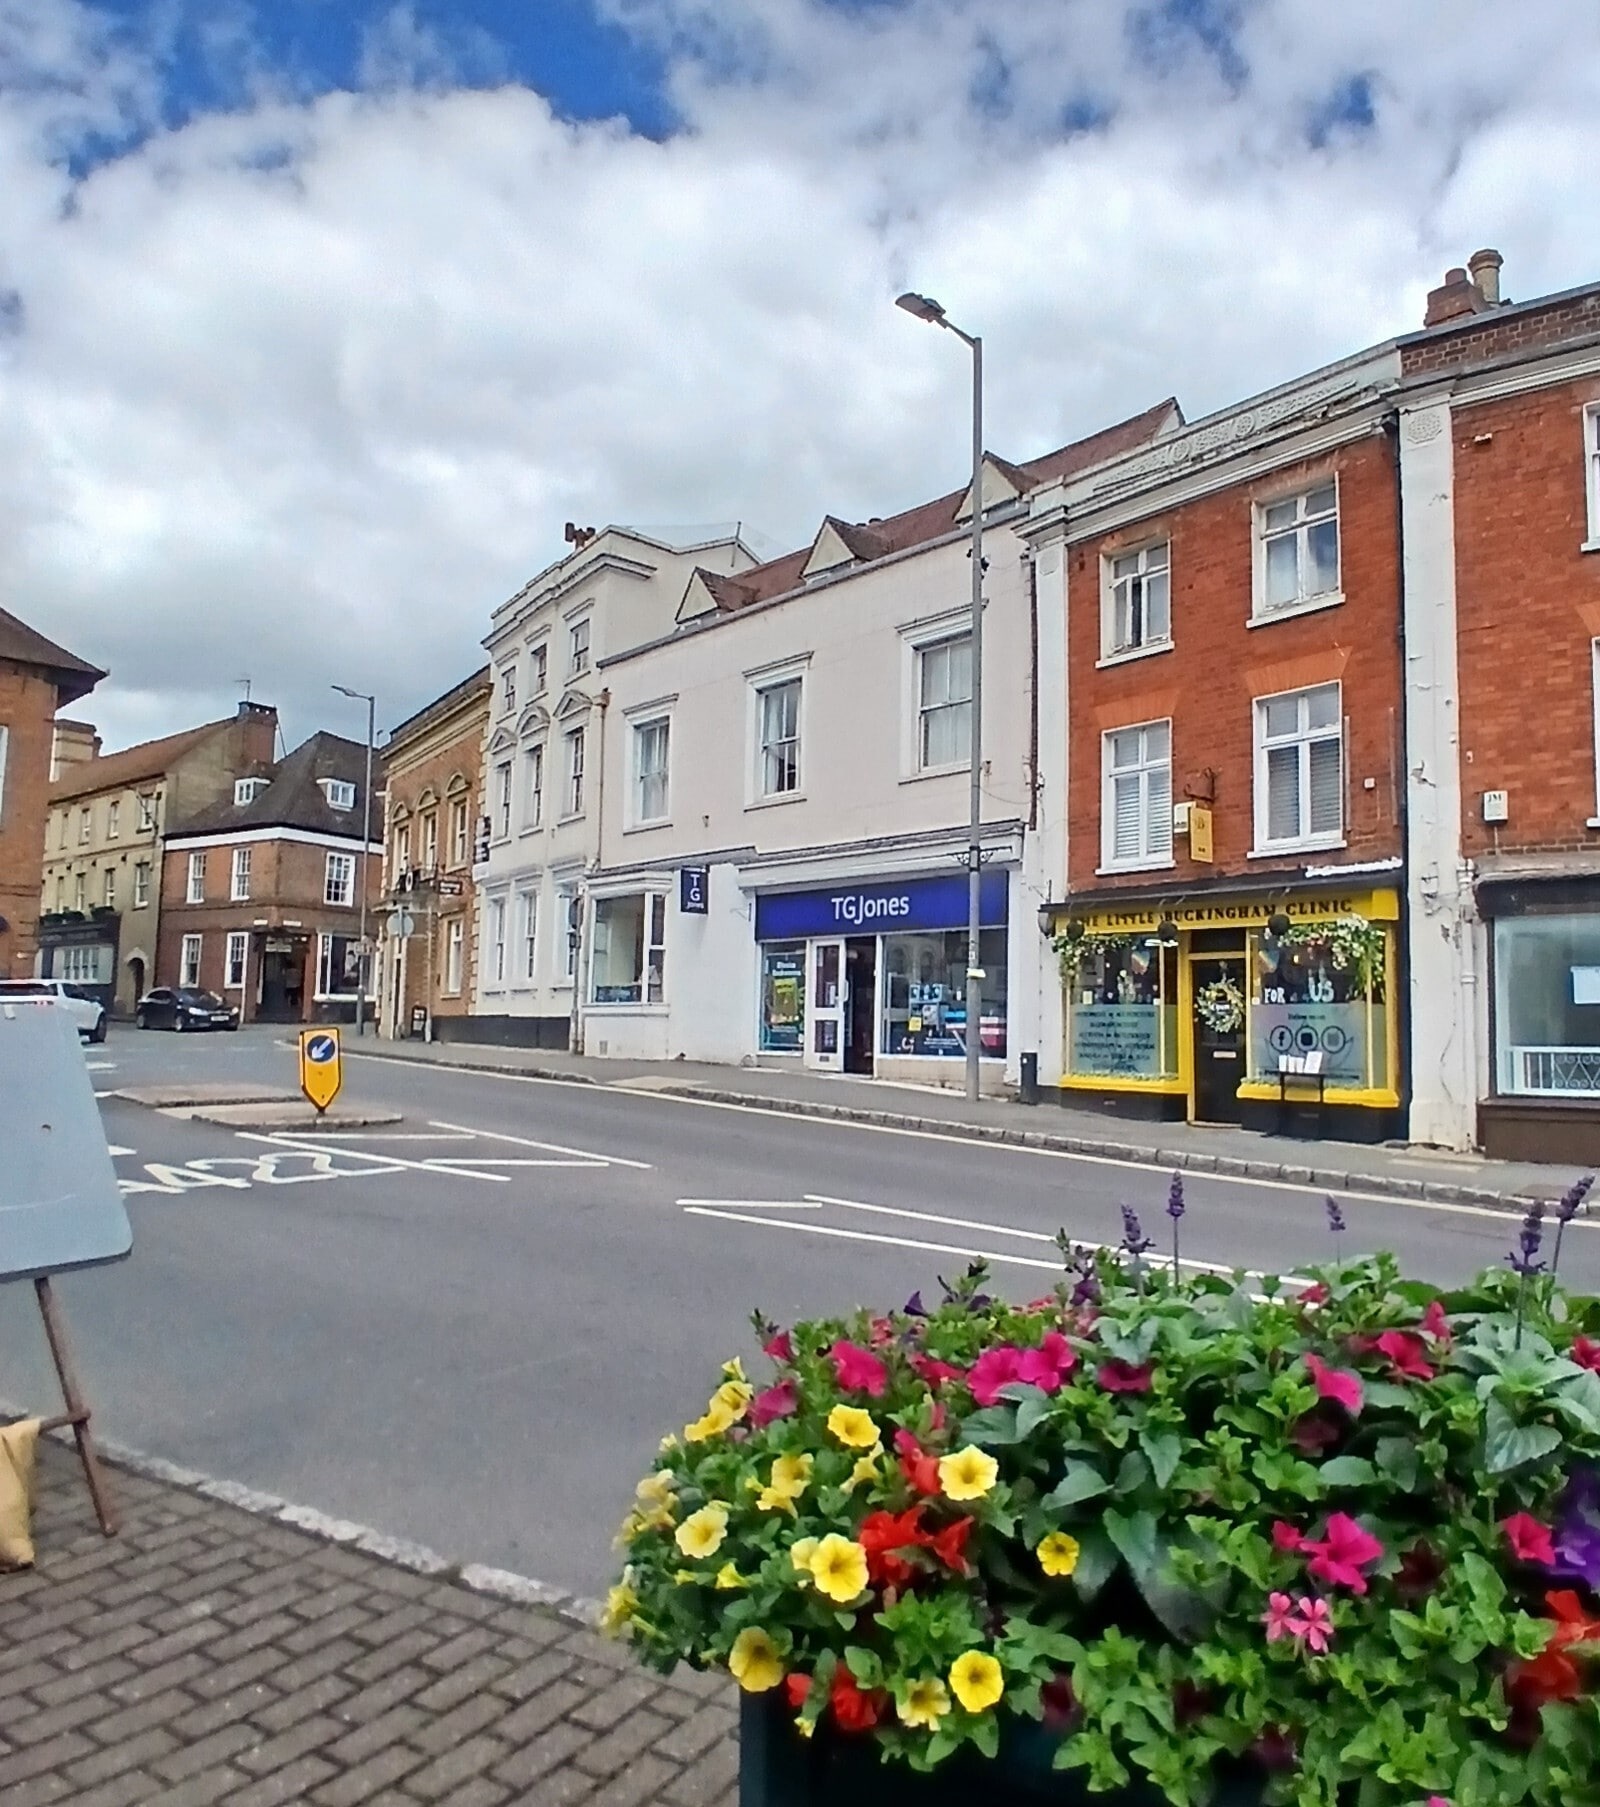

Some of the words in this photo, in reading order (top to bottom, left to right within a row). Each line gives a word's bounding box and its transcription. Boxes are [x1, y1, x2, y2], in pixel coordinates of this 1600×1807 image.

[689, 873, 701, 887] T
[689, 887, 701, 902] G
[1107, 911, 1154, 926] LITTLE
[1165, 903, 1276, 922] BUCKINGHAM
[1285, 899, 1352, 917] CLINIC
[1264, 986, 1286, 1004] FOR
[1308, 976, 1334, 1003] US
